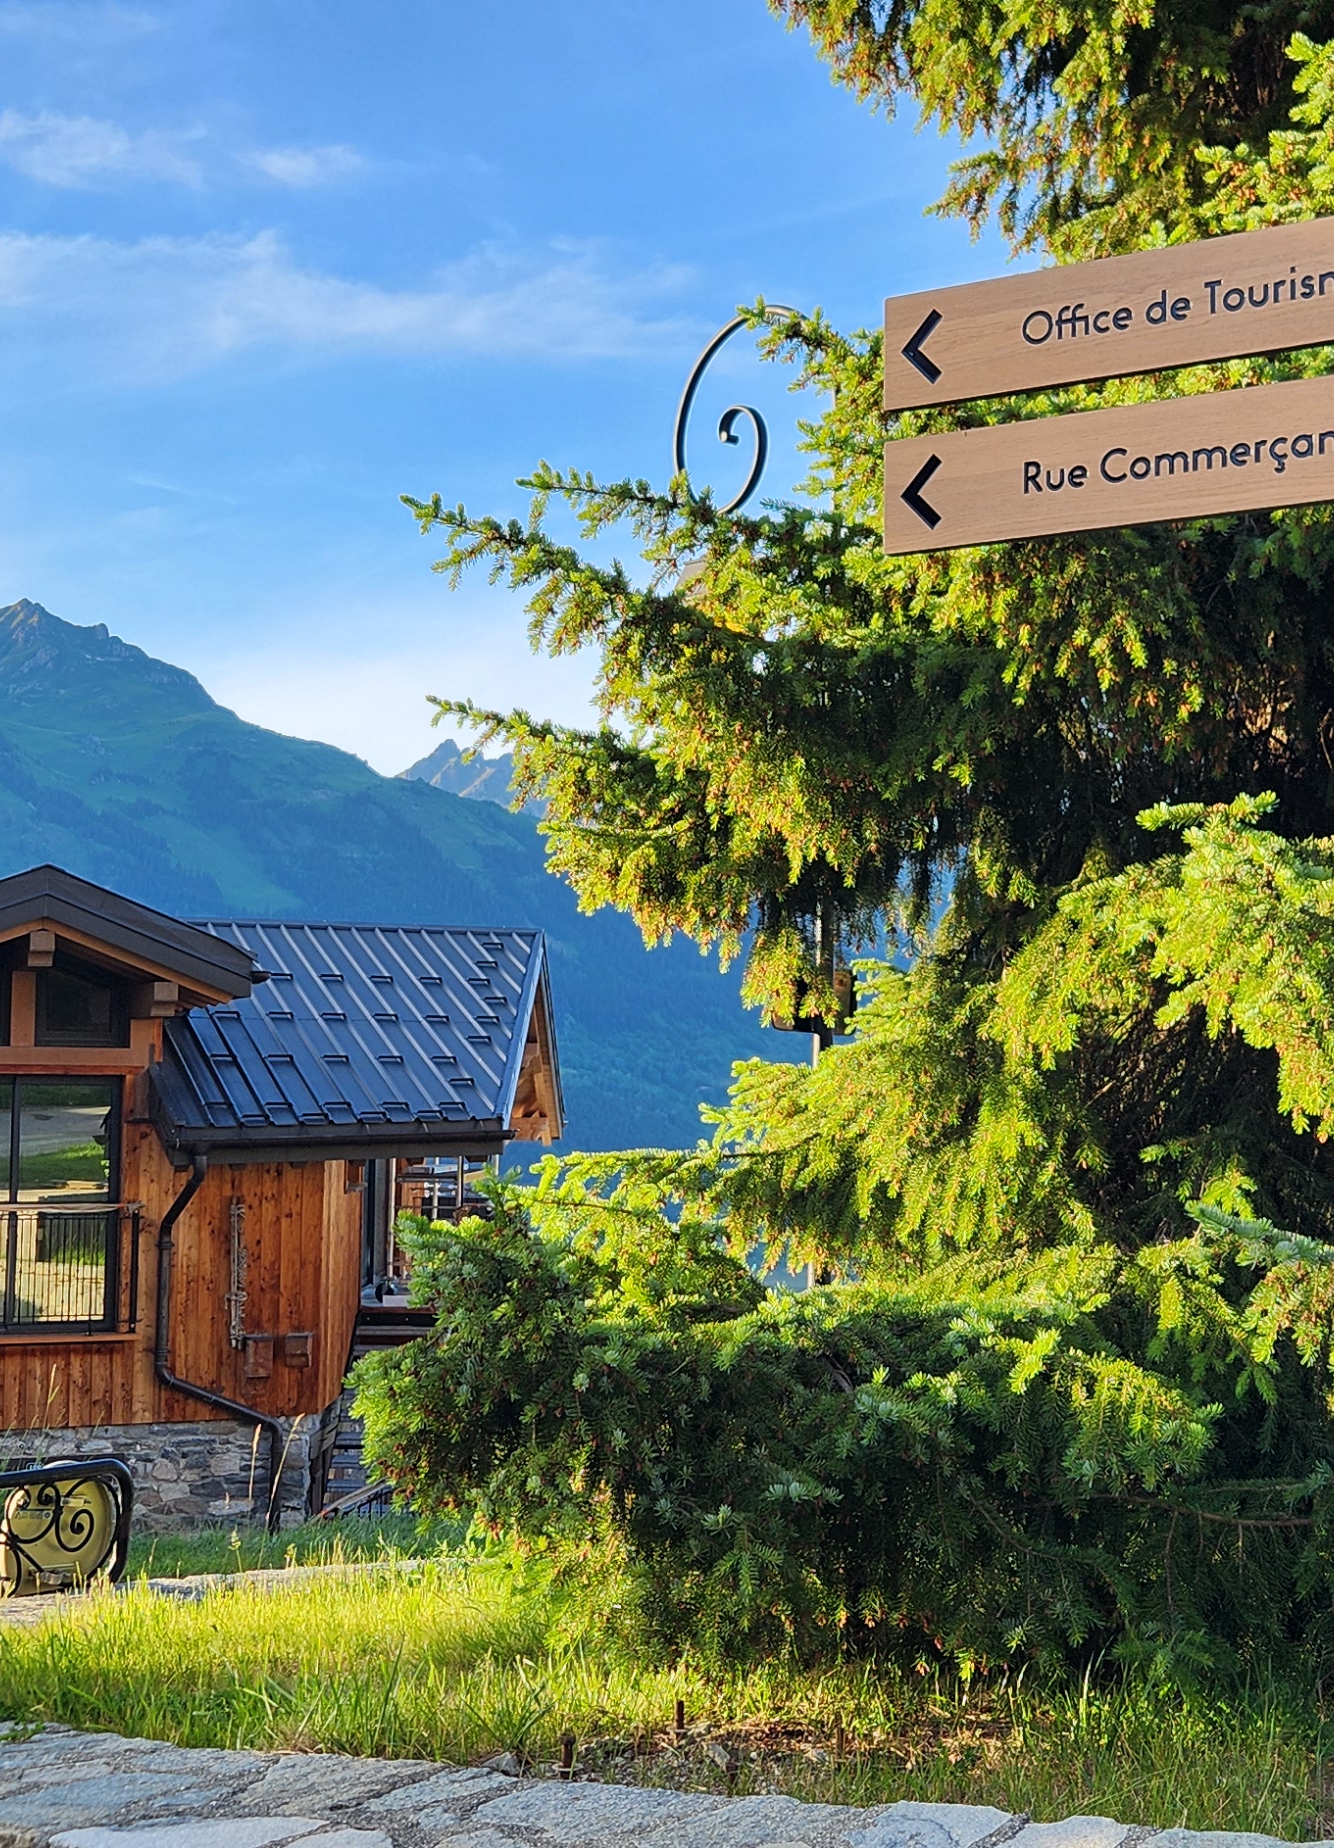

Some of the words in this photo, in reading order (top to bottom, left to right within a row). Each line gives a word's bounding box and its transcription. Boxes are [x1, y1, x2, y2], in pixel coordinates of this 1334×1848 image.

[1023, 302, 1133, 345] Office
[1145, 288, 1191, 325] de
[1023, 460, 1088, 495] Rue
